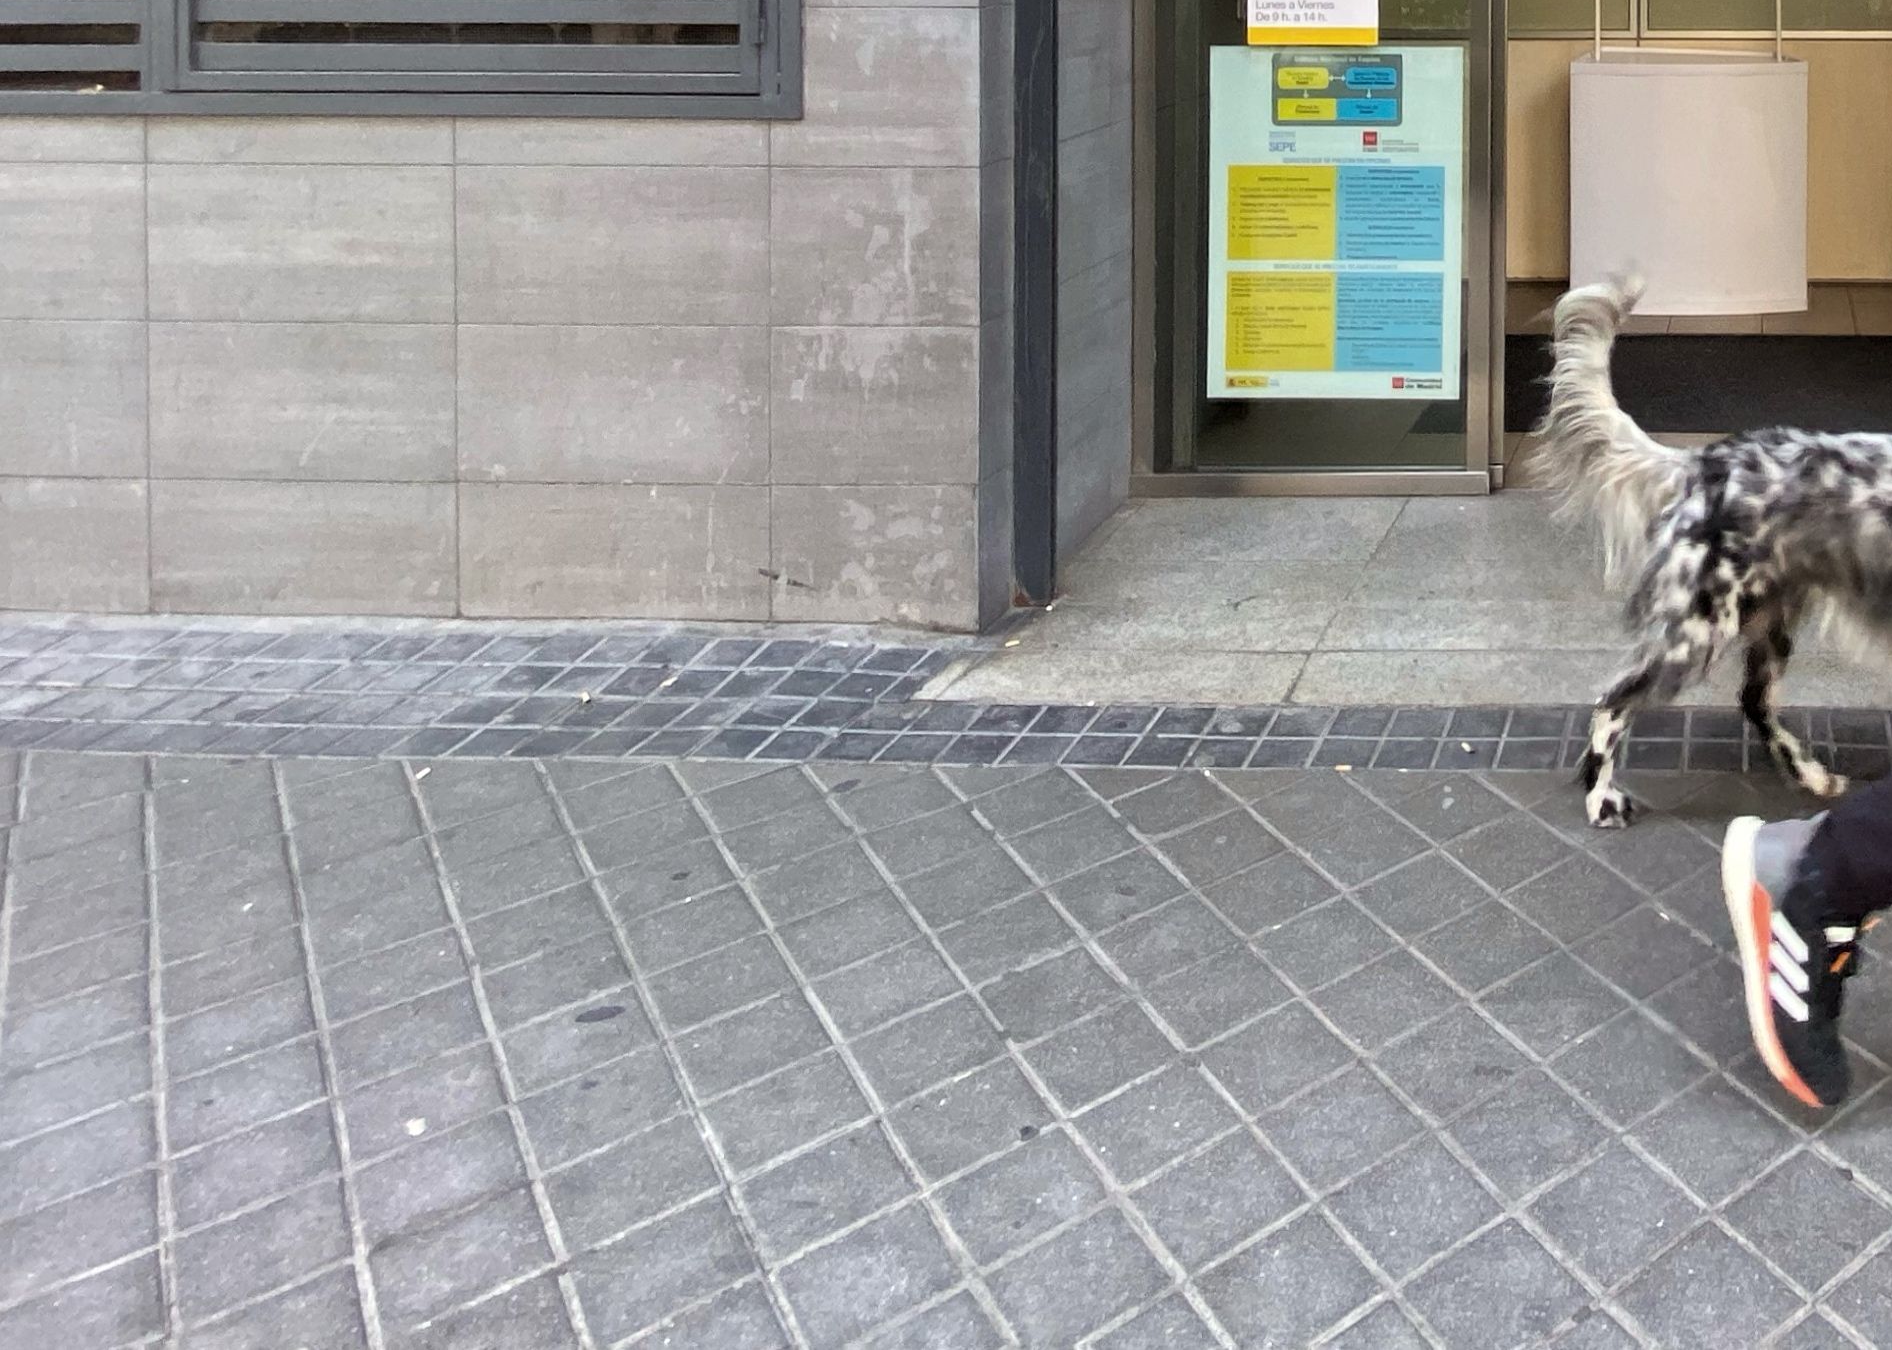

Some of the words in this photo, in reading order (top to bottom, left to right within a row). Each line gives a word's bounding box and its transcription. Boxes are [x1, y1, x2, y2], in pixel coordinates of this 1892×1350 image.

[1255, 0, 1286, 10] Lunes
[1289, 2, 1296, 10] a
[1298, 0, 1335, 10] Viernes
[1255, 12, 1270, 22] De
[1272, 12, 1280, 22] 9
[1294, 14, 1301, 22] a
[1303, 12, 1315, 22] 14
[1269, 142, 1296, 152] SEPE
